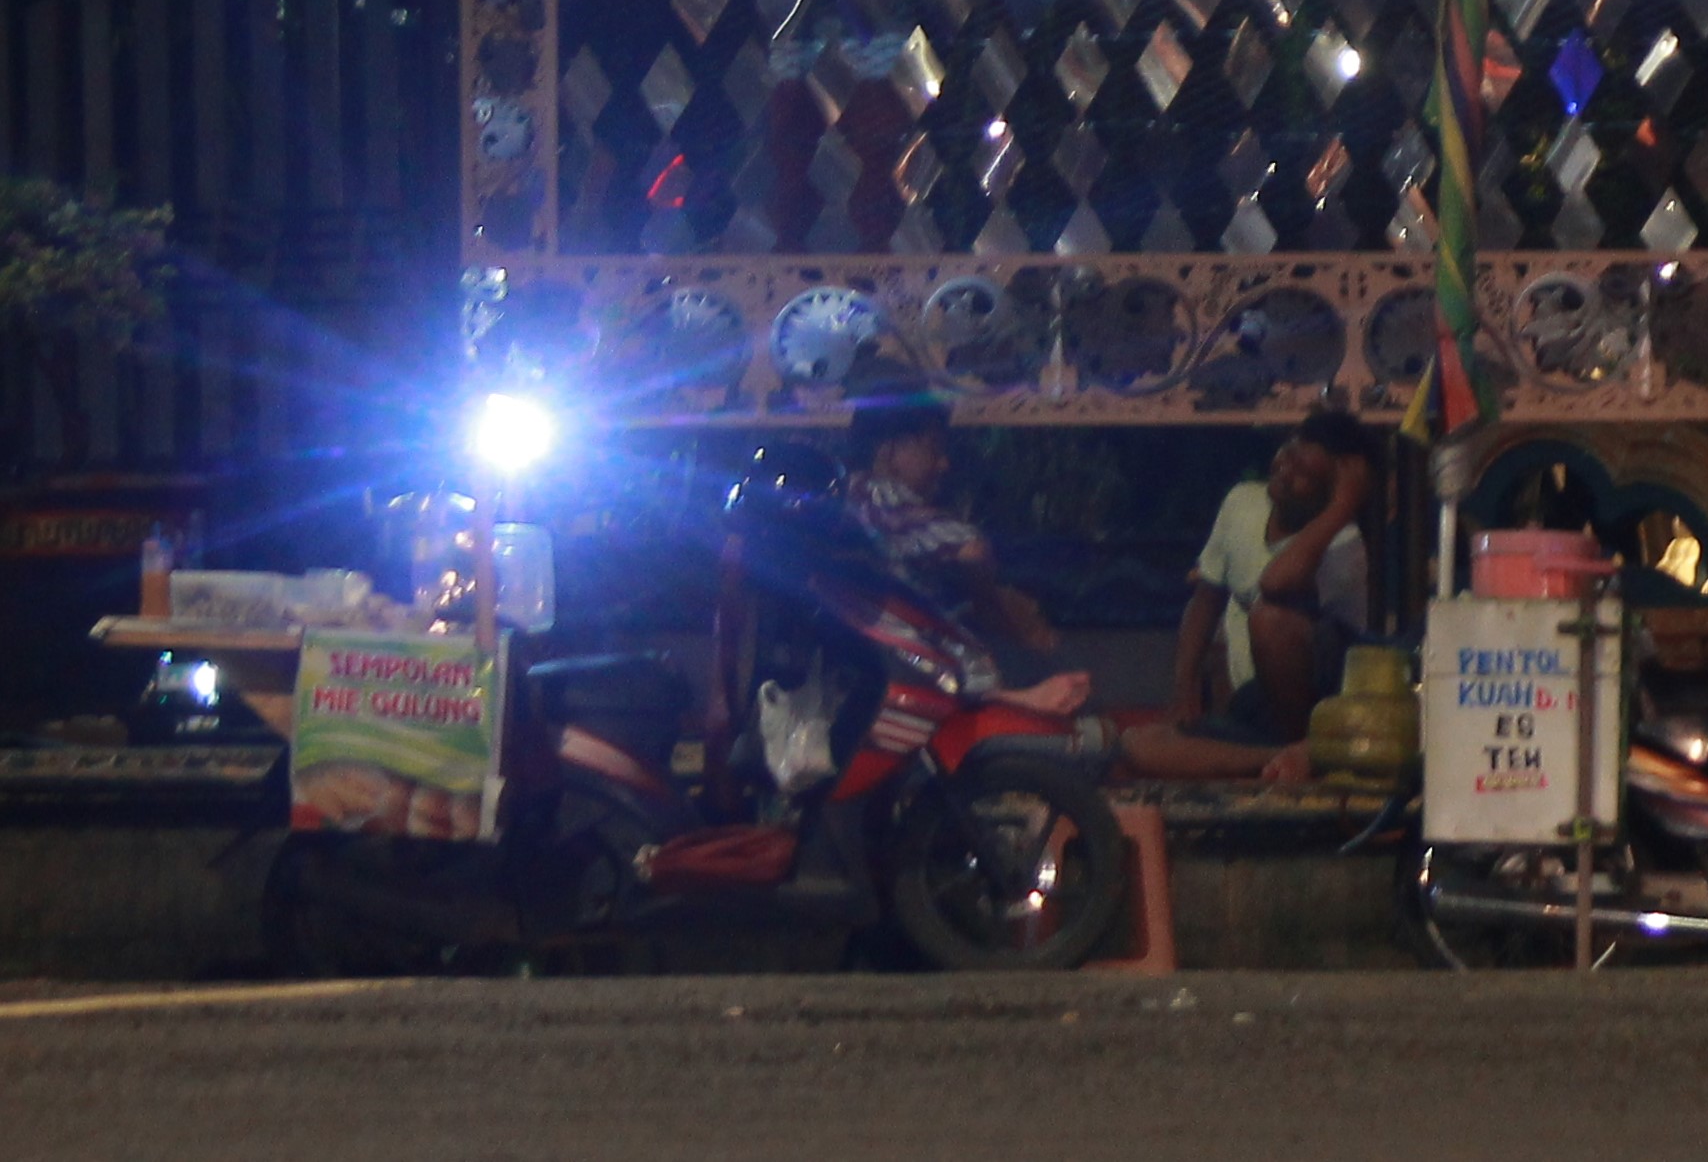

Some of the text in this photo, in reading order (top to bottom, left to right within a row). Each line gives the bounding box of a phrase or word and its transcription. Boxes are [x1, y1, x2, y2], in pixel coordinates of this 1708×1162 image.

[1458, 648, 1570, 675] PENTOL
[312, 686, 482, 724] MIE GULUNG
[1458, 680, 1533, 707] KUAH
[1484, 745, 1542, 770] TEH
